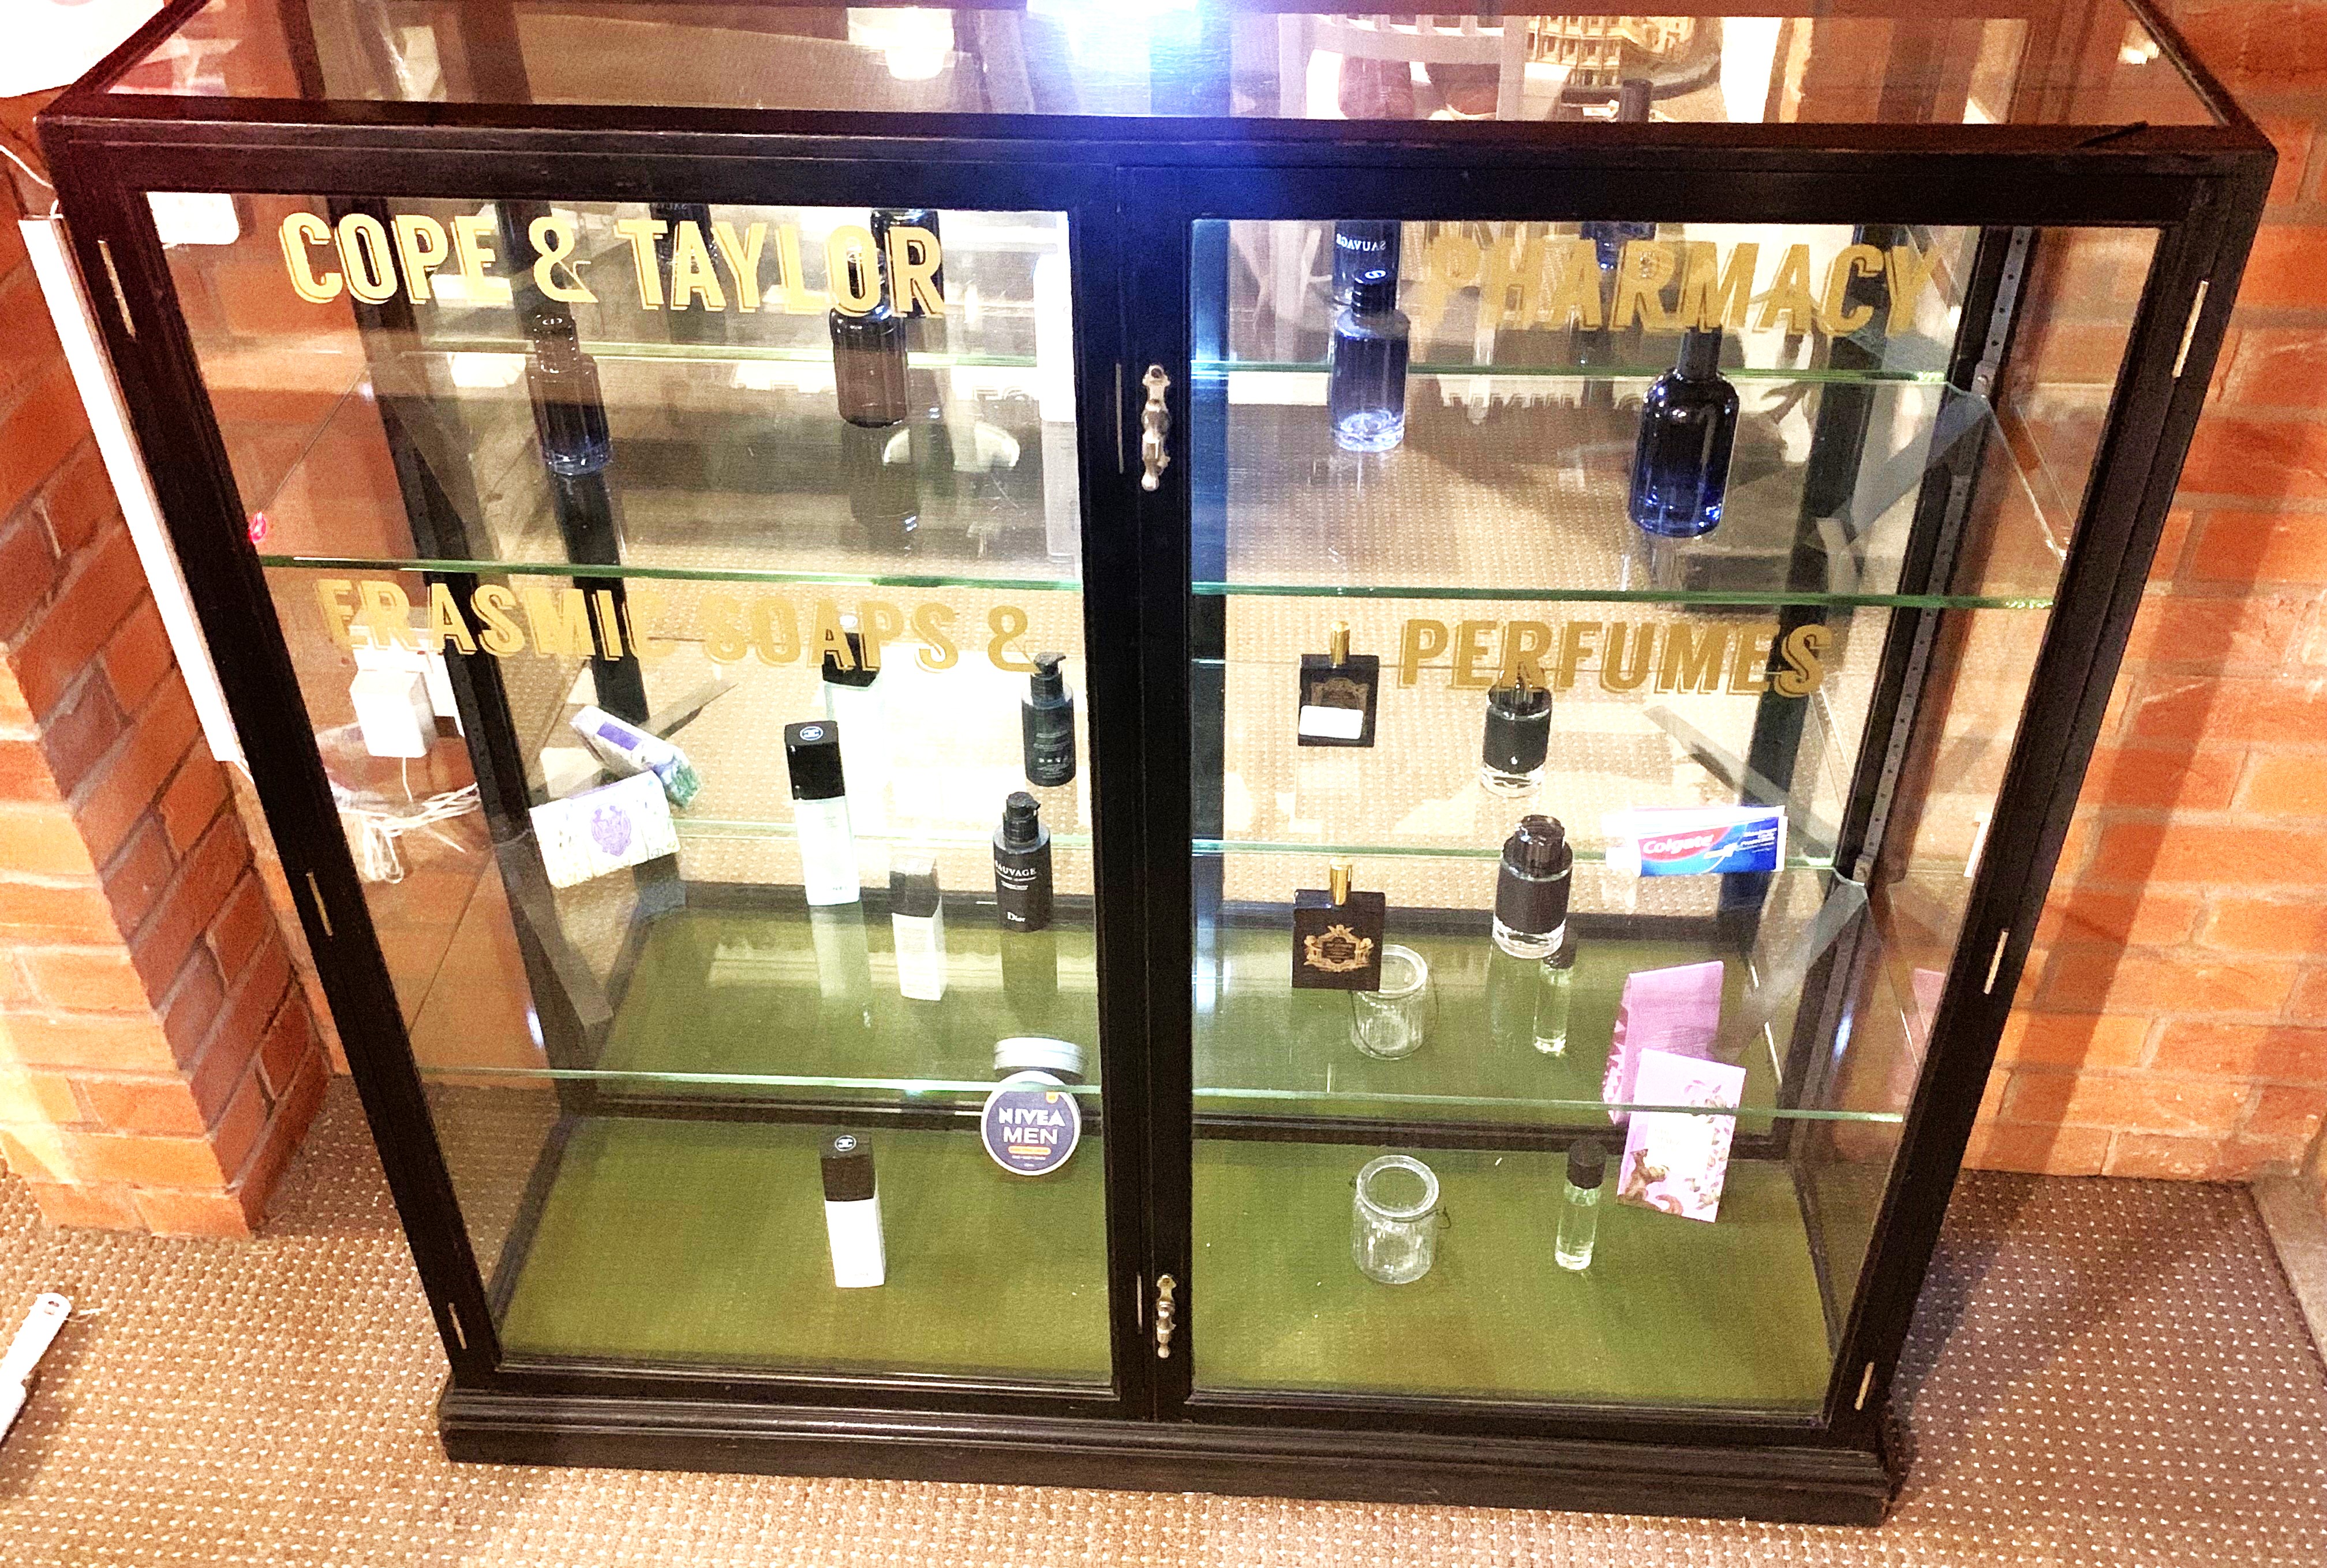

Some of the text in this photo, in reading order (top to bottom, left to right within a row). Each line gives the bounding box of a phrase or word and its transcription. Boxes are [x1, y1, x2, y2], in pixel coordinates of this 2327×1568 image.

[279, 212, 945, 318] COPE & TAYLOR
[1422, 235, 1944, 338] PHARMACY
[315, 578, 1041, 674] ERASMIC SOAPS &
[1397, 618, 1833, 699] PERFUMES
[1643, 834, 1715, 854] Colgate
[998, 1107, 1066, 1127] NIVEA
[1003, 1126, 1058, 1144] MEN
